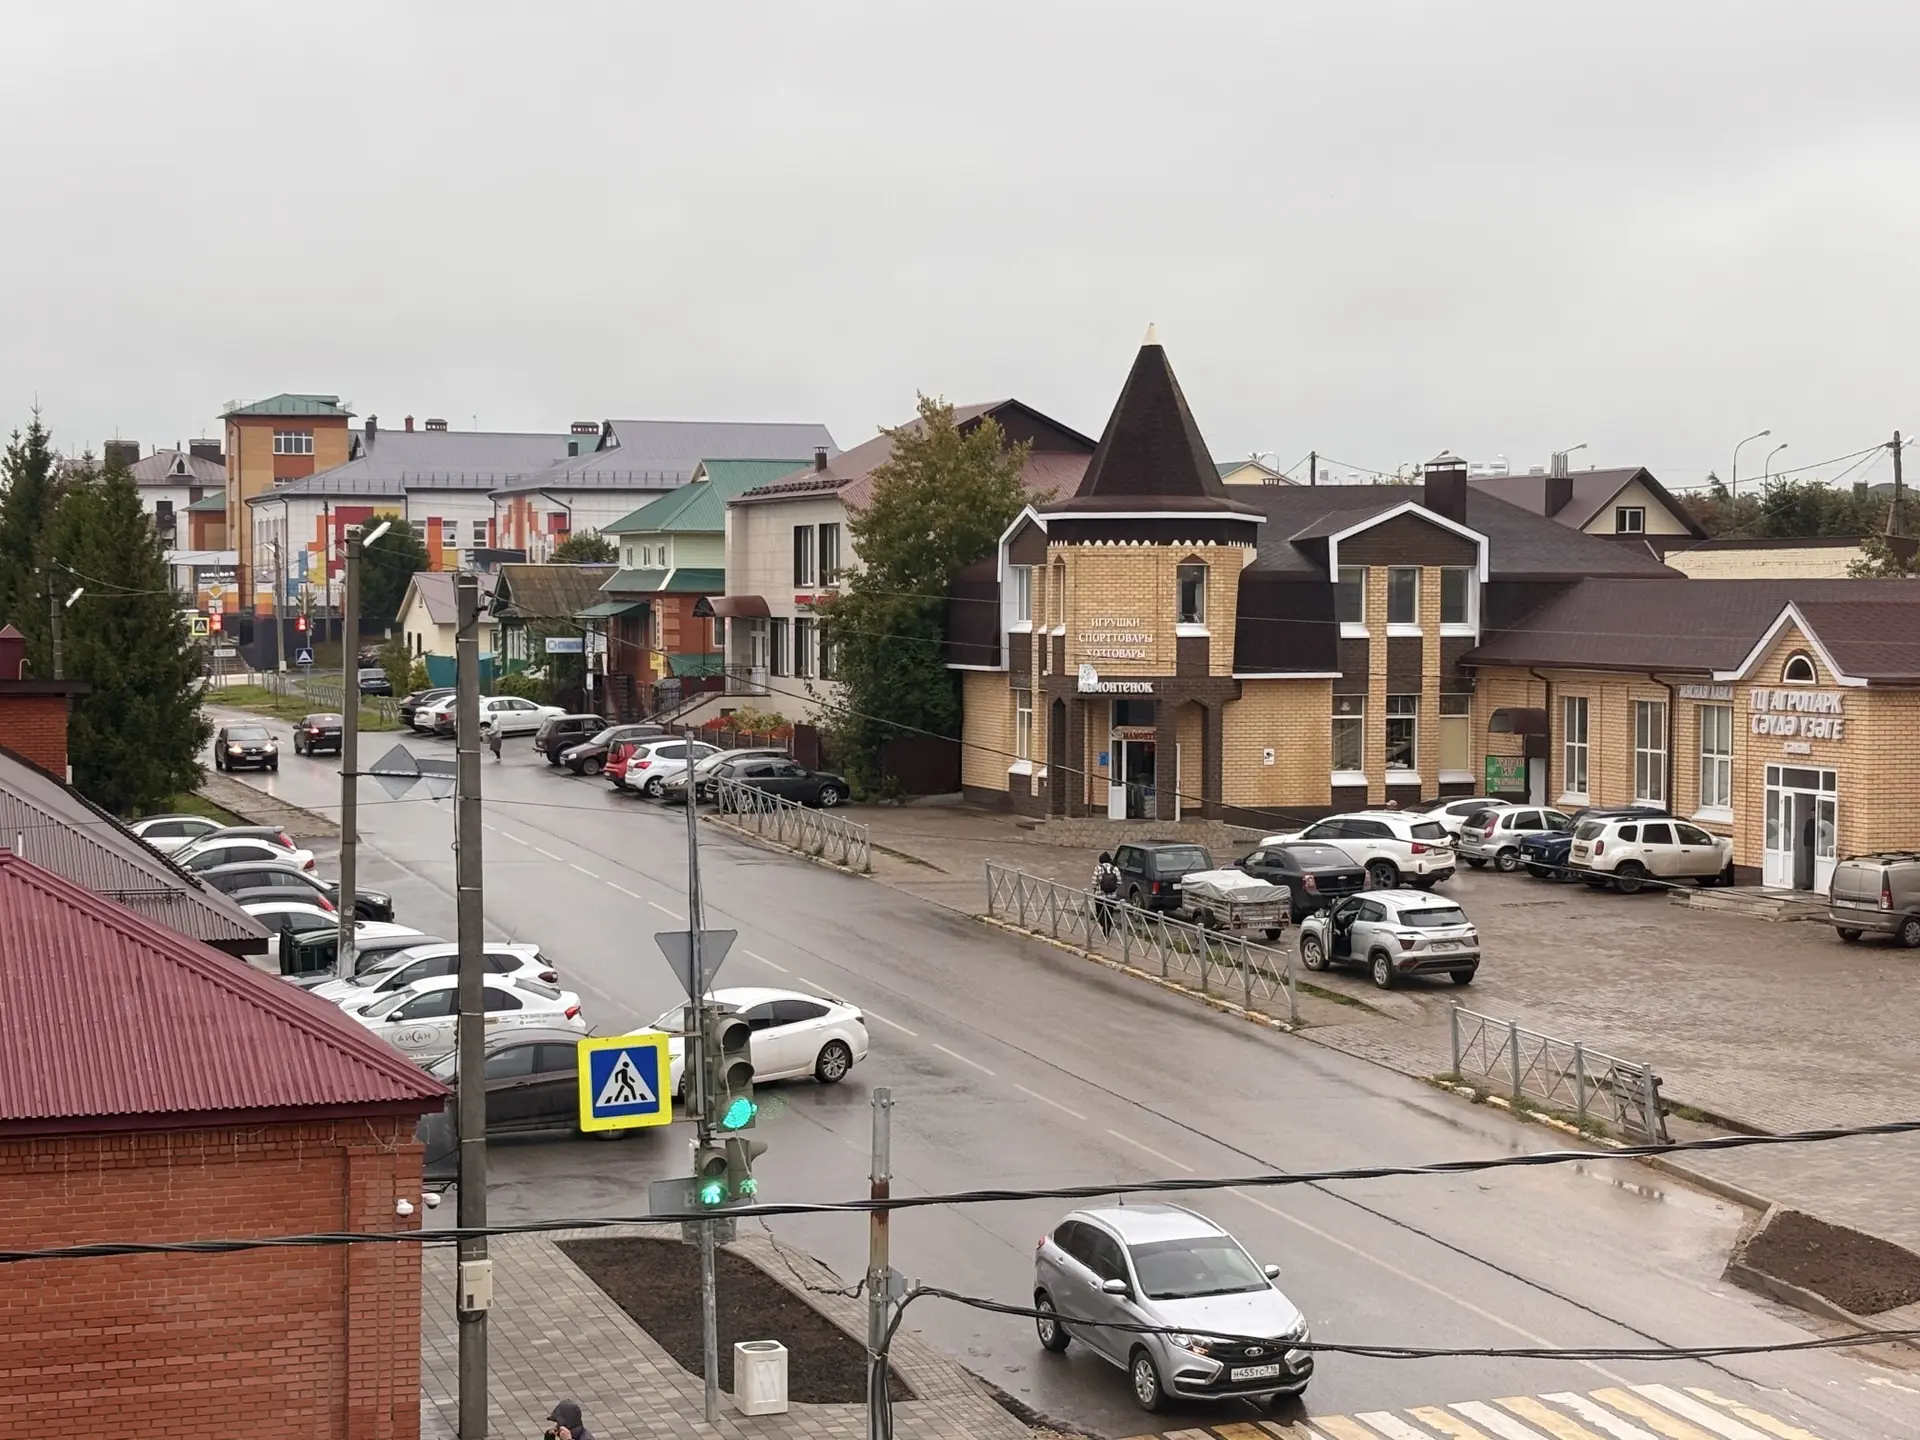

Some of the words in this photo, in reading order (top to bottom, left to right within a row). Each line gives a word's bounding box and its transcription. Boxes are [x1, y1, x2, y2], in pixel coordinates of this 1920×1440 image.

[1091, 617, 1140, 627] ИГРУШКИ
[1078, 633, 1153, 643] СПОРТТОВАРЫ
[1086, 649, 1146, 658] ХОЗТОВАРЫ
[1750, 689, 1769, 712] ТЦ
[1770, 691, 1844, 714] АГРОПАРК
